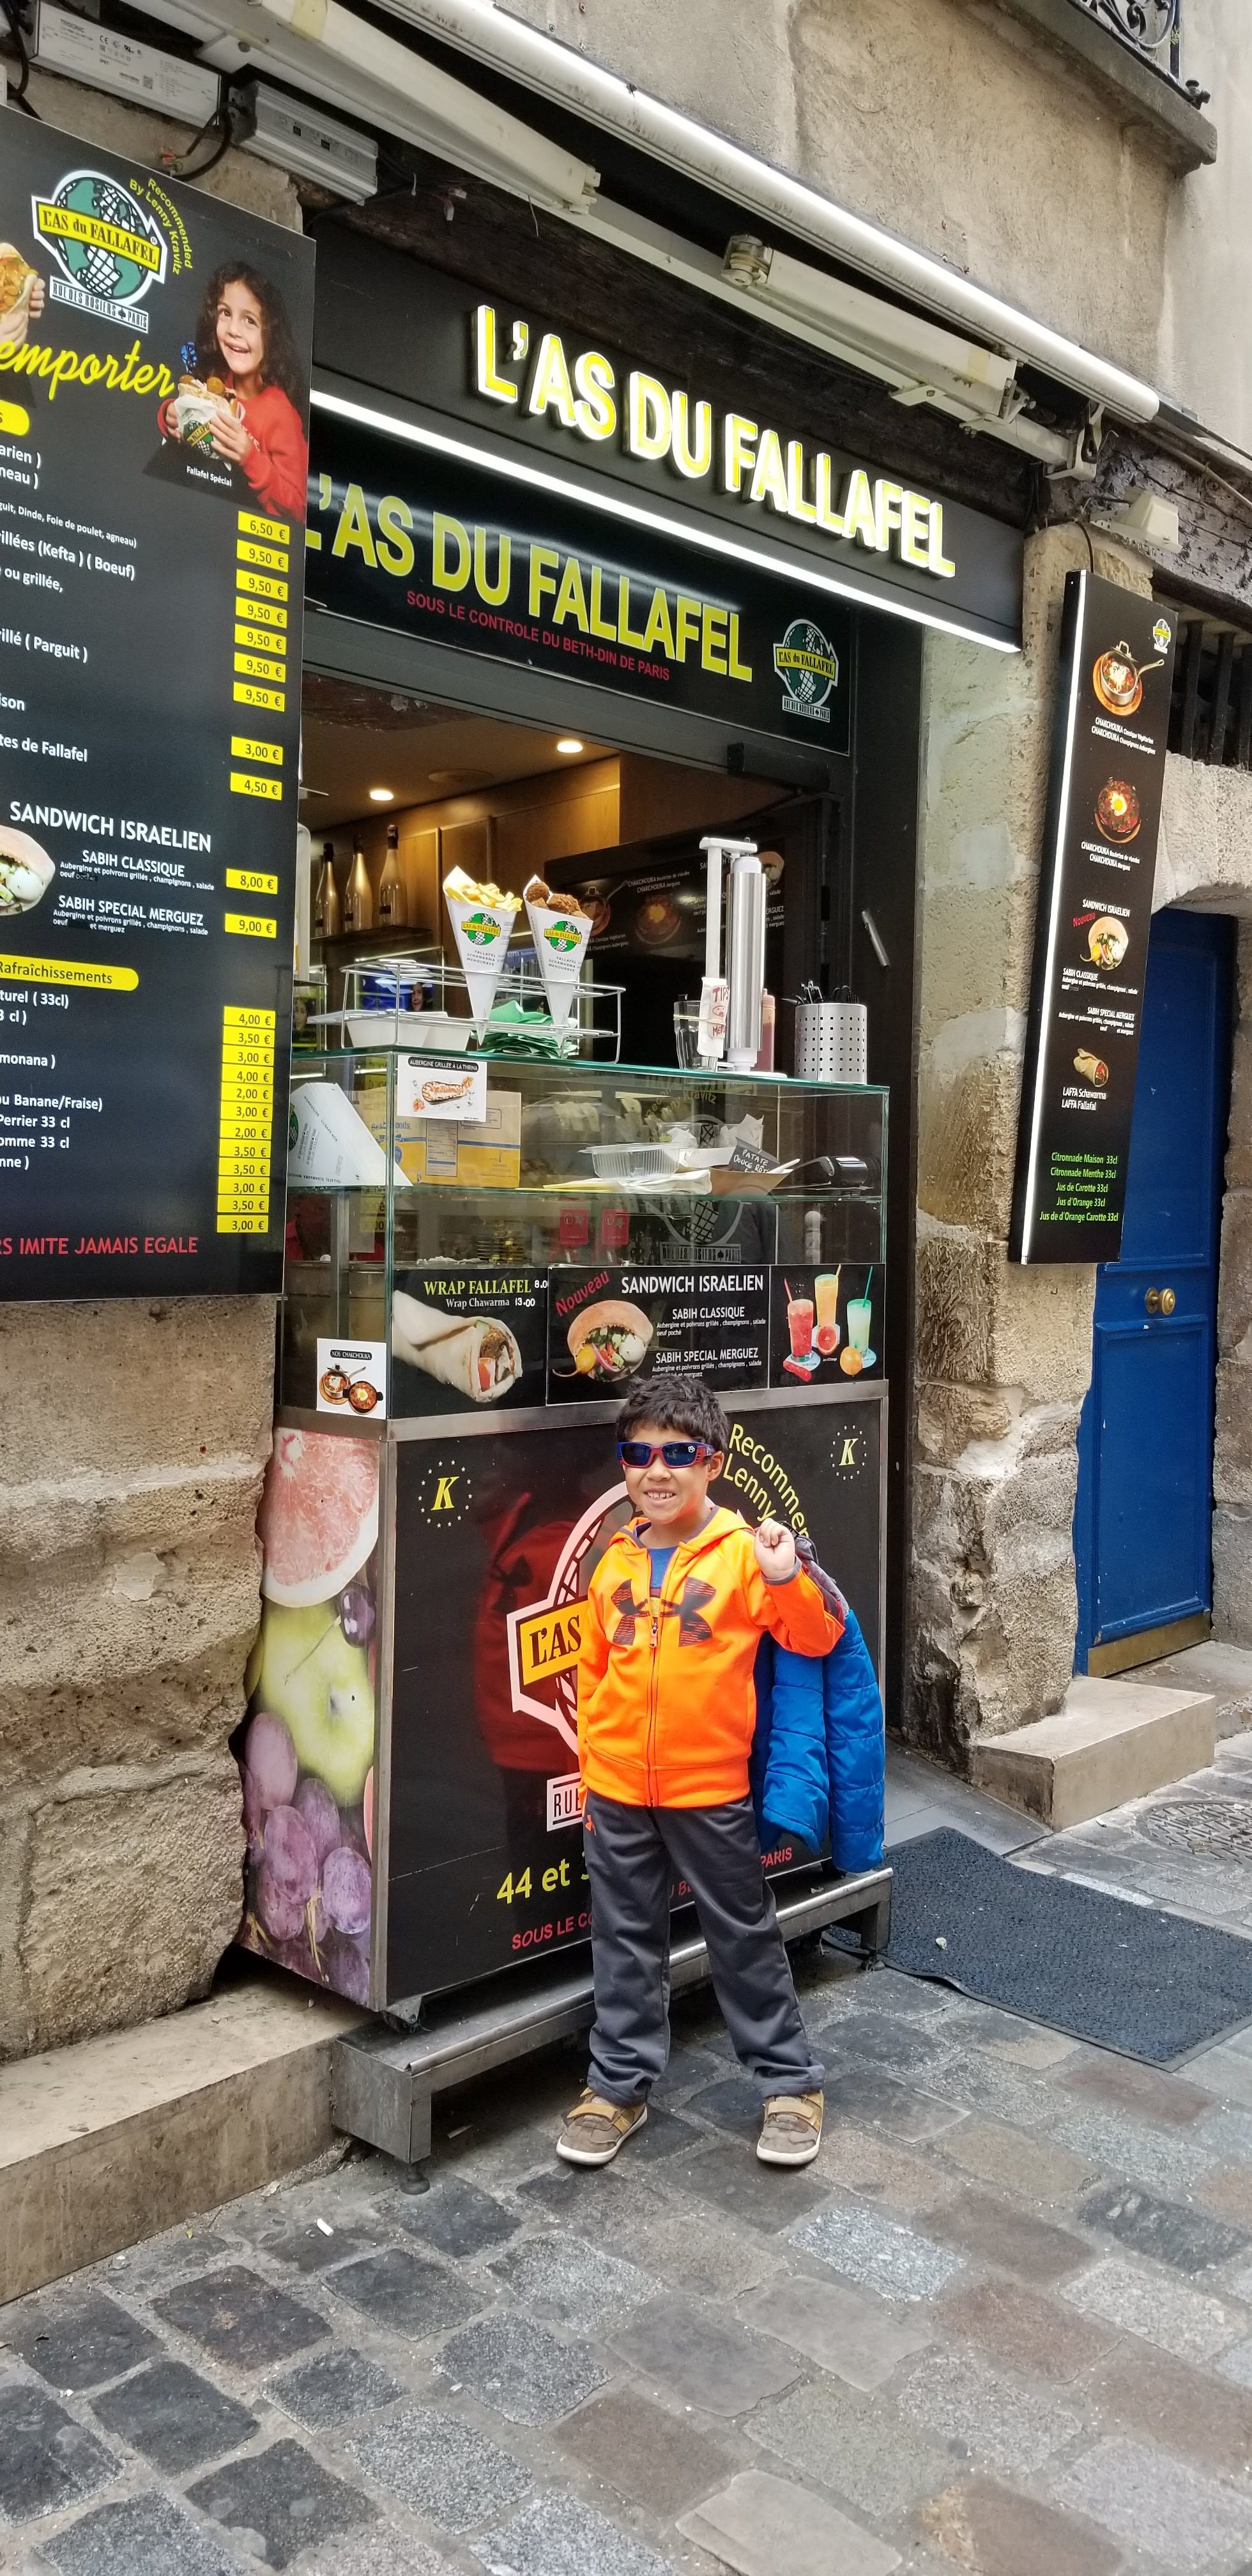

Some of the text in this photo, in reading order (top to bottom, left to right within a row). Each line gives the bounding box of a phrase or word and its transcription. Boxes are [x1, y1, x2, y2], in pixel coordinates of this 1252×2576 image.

[129, 178, 183, 275] By Lenny Kravitz
[148, 178, 193, 269] Recommended
[43, 210, 157, 266] L'AS du FALLAFEL
[68, 288, 82, 303] DES
[85, 294, 116, 317] ROSIERS
[128, 310, 147, 328] PARIS
[0, 340, 174, 401] emporter
[476, 305, 957, 579] L'AS DU FALLAFEL
[187, 466, 232, 487] Fallafel Spécial
[19, 507, 137, 549] Dinde, Foie de poulet, agneau)
[250, 520, 273, 537] 6,50
[249, 548, 271, 564] 9,50
[22, 572, 63, 594] grillée,
[248, 578, 271, 593] 9,50
[432, 511, 510, 607] DU
[528, 543, 752, 684] FALLAFEL
[247, 604, 270, 620] 9,50
[247, 631, 270, 647] 9,50
[407, 590, 671, 682] SOUS LE CONTROLE DU BETH-DIN DE PARIS
[33, 636, 80, 659] Parguit
[246, 659, 269, 675] 9,50
[801, 655, 834, 676] FALLAFEL
[245, 689, 268, 704] 9,50
[22, 737, 88, 762] de Fallafel
[245, 744, 268, 758] 3,00
[244, 779, 267, 793] 4,50
[10, 801, 211, 854] SANDWICH ISRAELIEN
[82, 850, 185, 878] SABIH CLASSIQUE
[60, 861, 93, 873] Aubergine
[102, 868, 128, 878] poivrons
[130, 871, 148, 881] grillés
[153, 876, 192, 888] champignons
[196, 882, 215, 891] salade
[240, 875, 263, 889] 8,00
[58, 895, 204, 927] SABIH SPECIAL MERGUEZ
[1082, 898, 1131, 918] SANDWICH ISRAELIEN
[53, 909, 185, 933] Aubergine champignons
[98, 924, 125, 933] merguez
[239, 919, 262, 933] 9,00
[239, 1013, 260, 1025] 4,00
[238, 1032, 259, 1045] 3,50
[238, 1052, 259, 1063] 3,00
[237, 1071, 258, 1083] 4,00
[236, 1088, 257, 1100] 2,00
[1062, 1086, 1106, 1100] LAFFA Schawarma
[15, 1094, 103, 1112] Banane/Fraise)
[1061, 1099, 1077, 1109] LAFFA
[236, 1107, 257, 1118] 3,00
[41, 1116, 56, 1128] 33
[61, 1117, 70, 1129] cl
[235, 1127, 256, 1139] 2,00
[40, 1136, 55, 1149] 33
[234, 1146, 256, 1158] 3,50
[742, 1149, 769, 1166] PATATE
[1051, 1152, 1118, 1165] Citronnade Maison 33cl
[733, 1154, 753, 1169] DOUCE
[234, 1164, 255, 1176] 3,50
[1050, 1167, 1117, 1179] Citronnade Menthe 33cl
[233, 1183, 255, 1195] 3,00
[1056, 1182, 1108, 1193] Jus de Carotte 33cl
[233, 1200, 254, 1212] 3,50
[1056, 1197, 1106, 1209] Jus d'Orange 33cl
[1039, 1211, 1118, 1223] Jus de d'Orange Carotte 33cl
[232, 1220, 253, 1232] 3,00
[20, 1236, 199, 1255] IMITE JAMAIS EGALE
[424, 1279, 532, 1296] WRAP FALLAFEL
[554, 1270, 764, 1317] Nouveau SANDWICH ISRAELIEN
[446, 1298, 468, 1310] Wrap
[469, 1297, 510, 1308] Chawarma
[672, 1306, 745, 1320] SABIH CLASSIQUE
[657, 1321, 680, 1330] Aubergine
[655, 1347, 759, 1364] SABIH SPECIAL MERGUEZ
[838, 1438, 859, 1466] K
[431, 1476, 460, 1512] K
[722, 1453, 777, 1522] Lenny
[528, 1615, 581, 1669] L'AS
[496, 1871, 533, 1905] 44
[542, 1858, 570, 1893] et
[512, 1919, 575, 1951] SOUS LE
